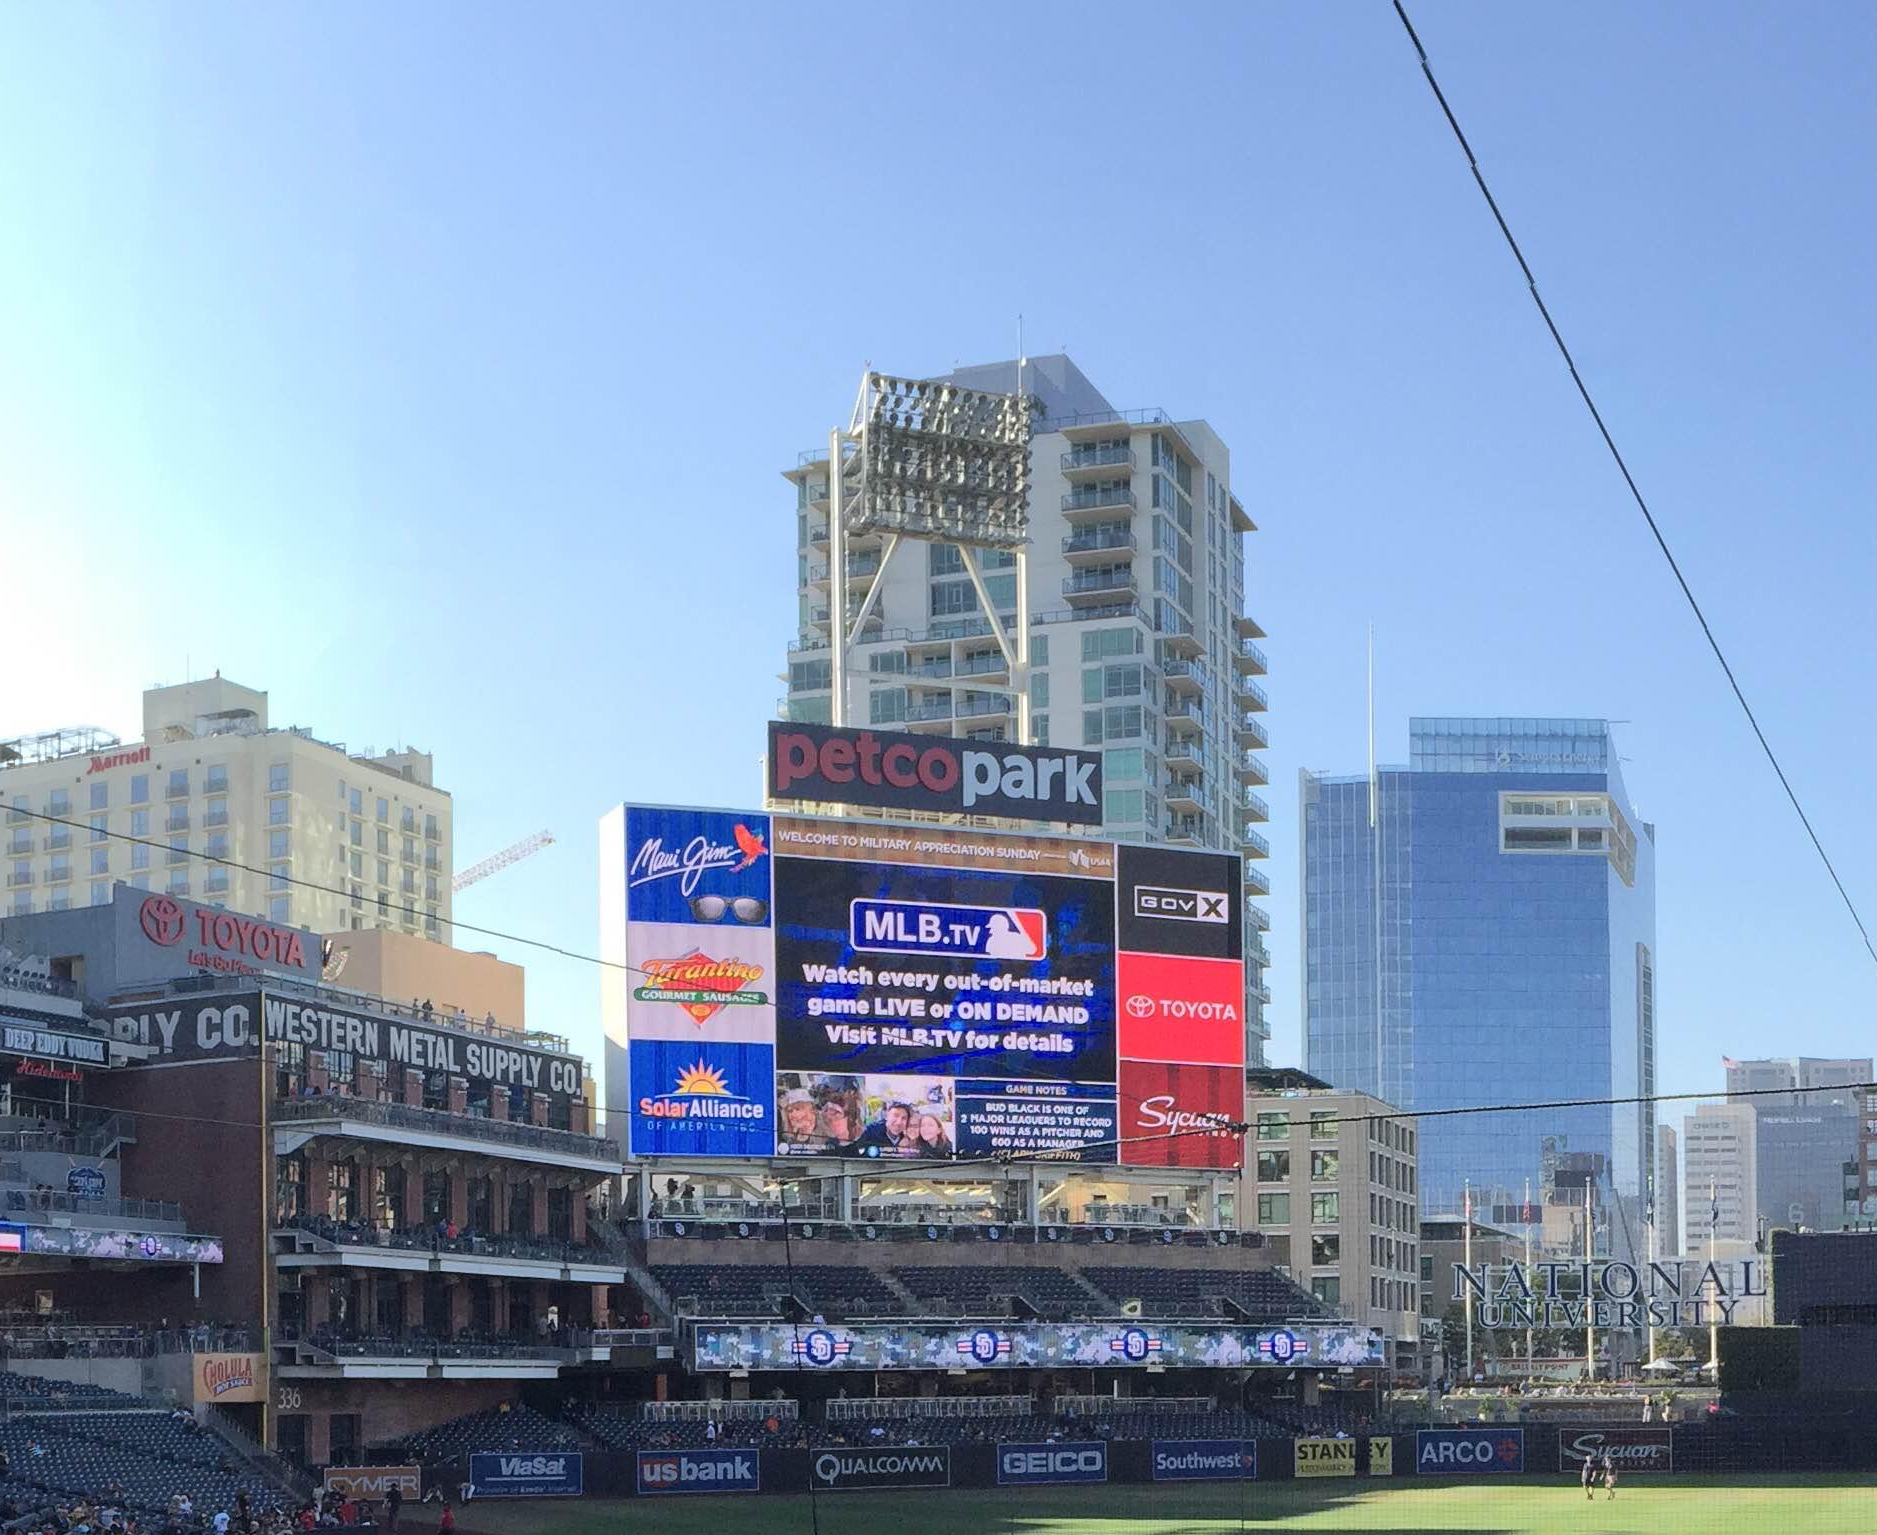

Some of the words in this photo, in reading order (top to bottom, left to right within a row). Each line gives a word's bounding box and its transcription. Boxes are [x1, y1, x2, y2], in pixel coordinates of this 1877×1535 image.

[86, 746, 151, 775] Marriott
[631, 838, 680, 876] Maui
[779, 831, 839, 846] WELCOME
[841, 835, 858, 847] TO
[860, 837, 911, 851] MILITARY
[914, 840, 994, 857] APPRECIATION
[996, 845, 1041, 862] SUNDAY
[195, 908, 306, 969] TOYOTA
[864, 909, 981, 947] MLB.TV
[641, 955, 765, 988] Tarantino
[802, 963, 873, 985] Watch
[877, 969, 940, 992] every
[943, 971, 1094, 997] out-of-market
[641, 990, 696, 1001] GOURMET
[807, 997, 870, 1017] game
[874, 997, 925, 1018] LIVE
[929, 1002, 952, 1019] or
[956, 1002, 992, 1021] ON
[996, 1004, 1089, 1025] DEMAND
[1159, 1000, 1237, 1021] TOYOTA
[196, 1004, 260, 1050] CO.
[825, 1024, 877, 1045] Visit
[881, 1028, 963, 1049] MLB.TV
[965, 1030, 1000, 1050] for
[1002, 1032, 1074, 1053] details
[4, 1026, 35, 1052] DEEP
[35, 1031, 66, 1057] EDDY
[67, 1035, 105, 1062] VODKA
[265, 999, 379, 1056] WESTERN
[389, 1025, 461, 1074] METAL
[466, 1043, 542, 1088] SUPPLY
[549, 1060, 581, 1096] CO.
[1005, 1084, 1034, 1095] GAME
[1035, 1085, 1067, 1096] NOTES
[960, 1113, 968, 1124] 2
[970, 1114, 1005, 1125] MAJOR
[1006, 1115, 1056, 1126] LEAGUERS
[1057, 1116, 1071, 1126] TO
[1073, 1117, 1113, 1128] RECORD
[985, 1102, 1007, 1113] BUD
[1008, 1103, 1040, 1114] BLACK
[1042, 1104, 1052, 1114] IS
[1053, 1105, 1074, 1115] ONE
[1076, 1105, 1090, 1115] OF
[646, 1121, 663, 1131] OF
[970, 1125, 989, 1136] 100
[989, 1126, 1015, 1137] WINS
[1017, 1127, 1030, 1137] AS
[1042, 1127, 1081, 1139] PITCHER
[1083, 1129, 1105, 1139] AND
[1013, 1137, 1026, 1147] AS
[1037, 1137, 1084, 1149] MANAGER
[1787, 1203, 1805, 1223] 6
[1452, 1260, 1768, 1301] NATIONAL
[1478, 1299, 1740, 1328] UNIVERSITY
[203, 1357, 253, 1387] CHOLULA
[277, 1387, 301, 1409] 336
[1156, 1452, 1242, 1470] Southwest
[1420, 1440, 1494, 1464] ARCO
[1566, 1433, 1662, 1462] Sycuan
[815, 1453, 945, 1485] QUALCOMM
[1002, 1450, 1103, 1475] GEICO
[327, 1475, 419, 1495] CYMER
